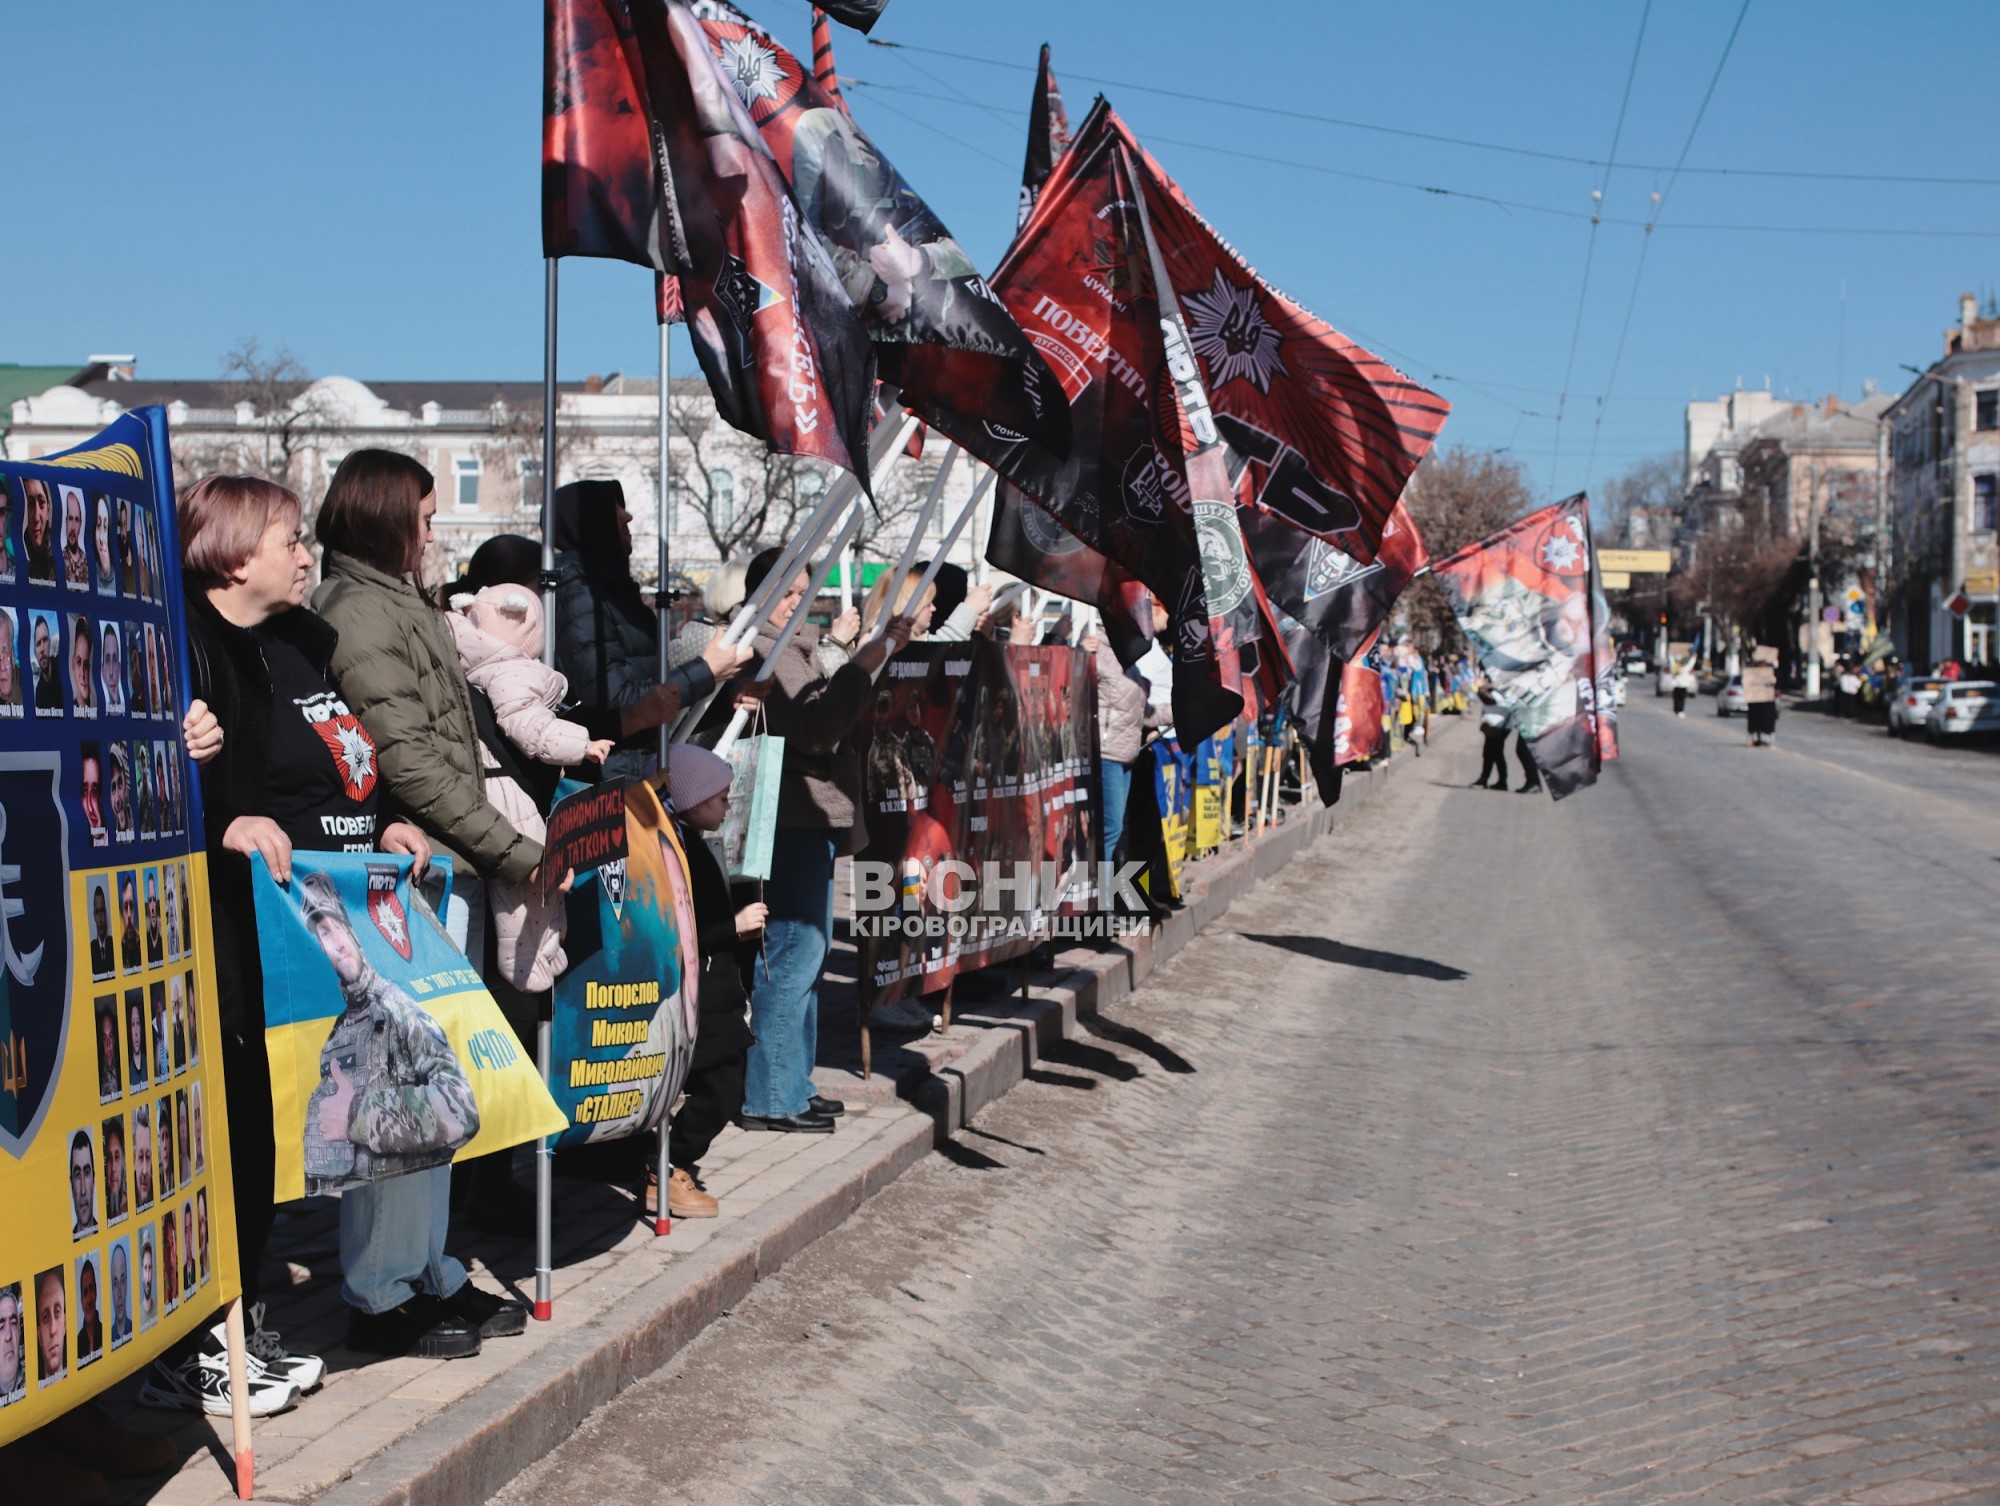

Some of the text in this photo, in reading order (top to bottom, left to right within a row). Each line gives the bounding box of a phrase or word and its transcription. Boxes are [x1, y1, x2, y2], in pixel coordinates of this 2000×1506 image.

[1032, 295, 1149, 409] ПОВЕРНІТ
[1160, 318, 1217, 444] ЛЮТЬ
[567, 828, 610, 869] ТАТКОМ
[586, 980, 660, 1010] Погорєлов
[591, 1018, 649, 1048] Микола
[569, 1051, 666, 1089] Миколайович
